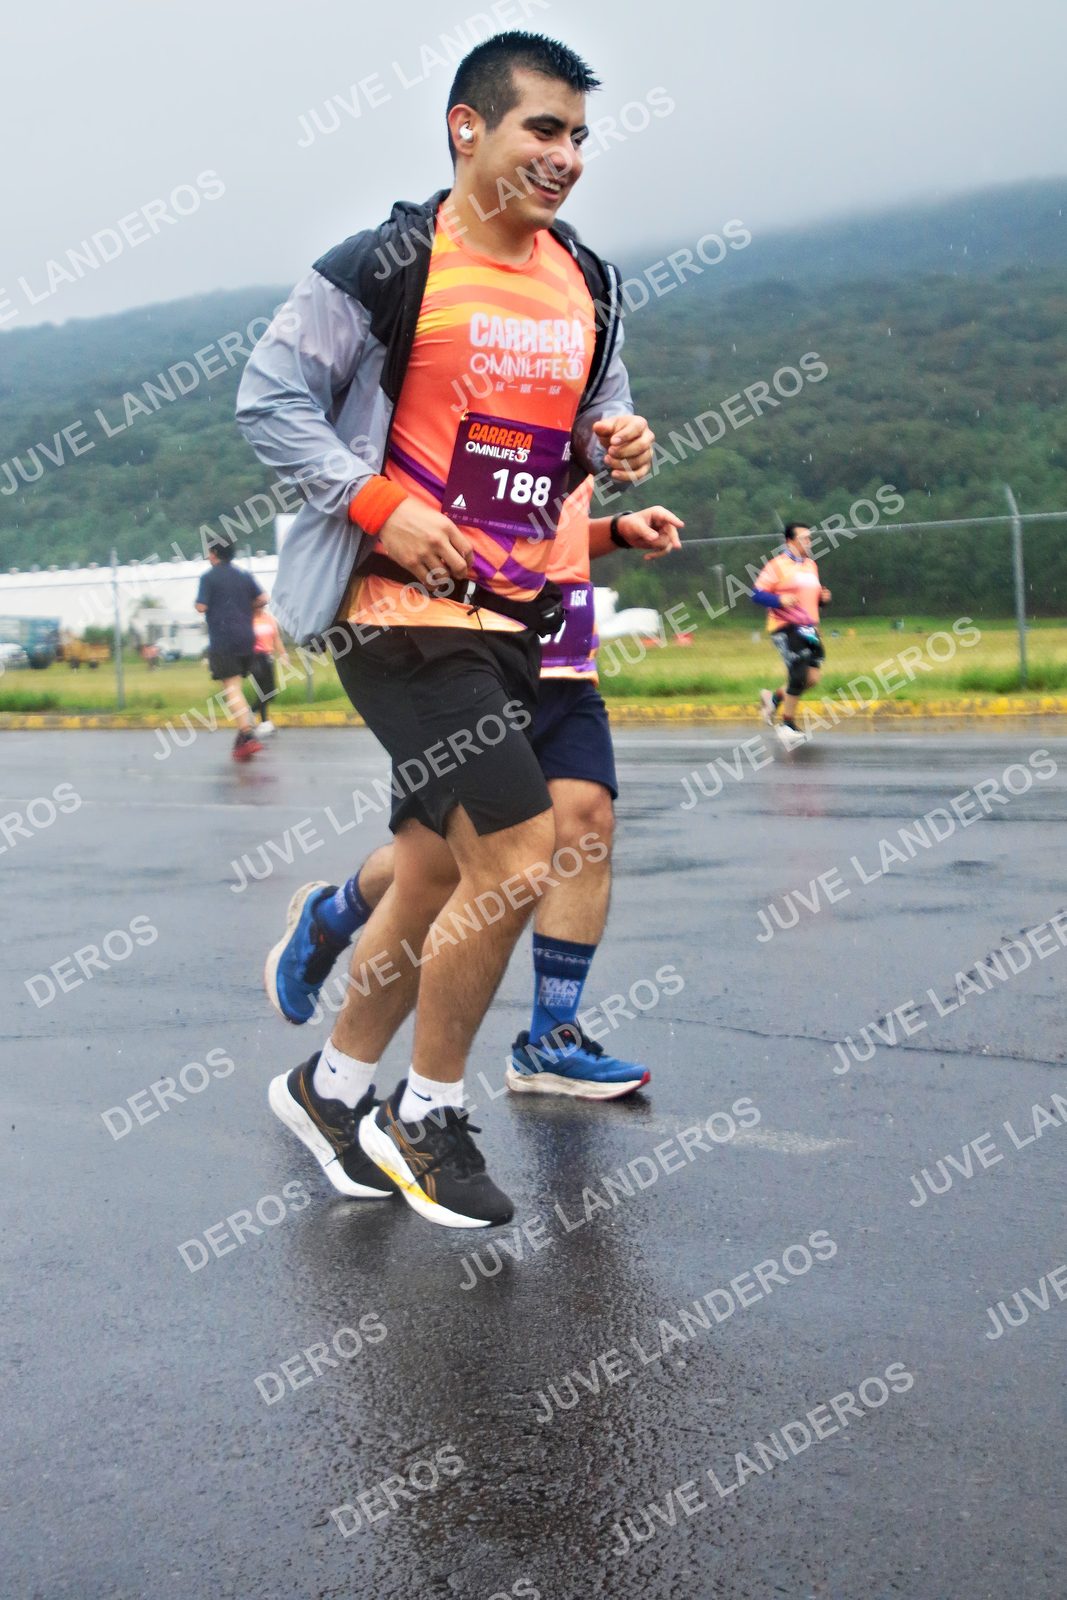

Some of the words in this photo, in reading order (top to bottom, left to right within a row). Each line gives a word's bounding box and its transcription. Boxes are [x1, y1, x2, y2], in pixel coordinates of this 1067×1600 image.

[470, 311, 585, 355] CARRERA
[468, 422, 533, 450] CARRERA
[493, 468, 552, 507] 188
[570, 589, 588, 607] 15K
